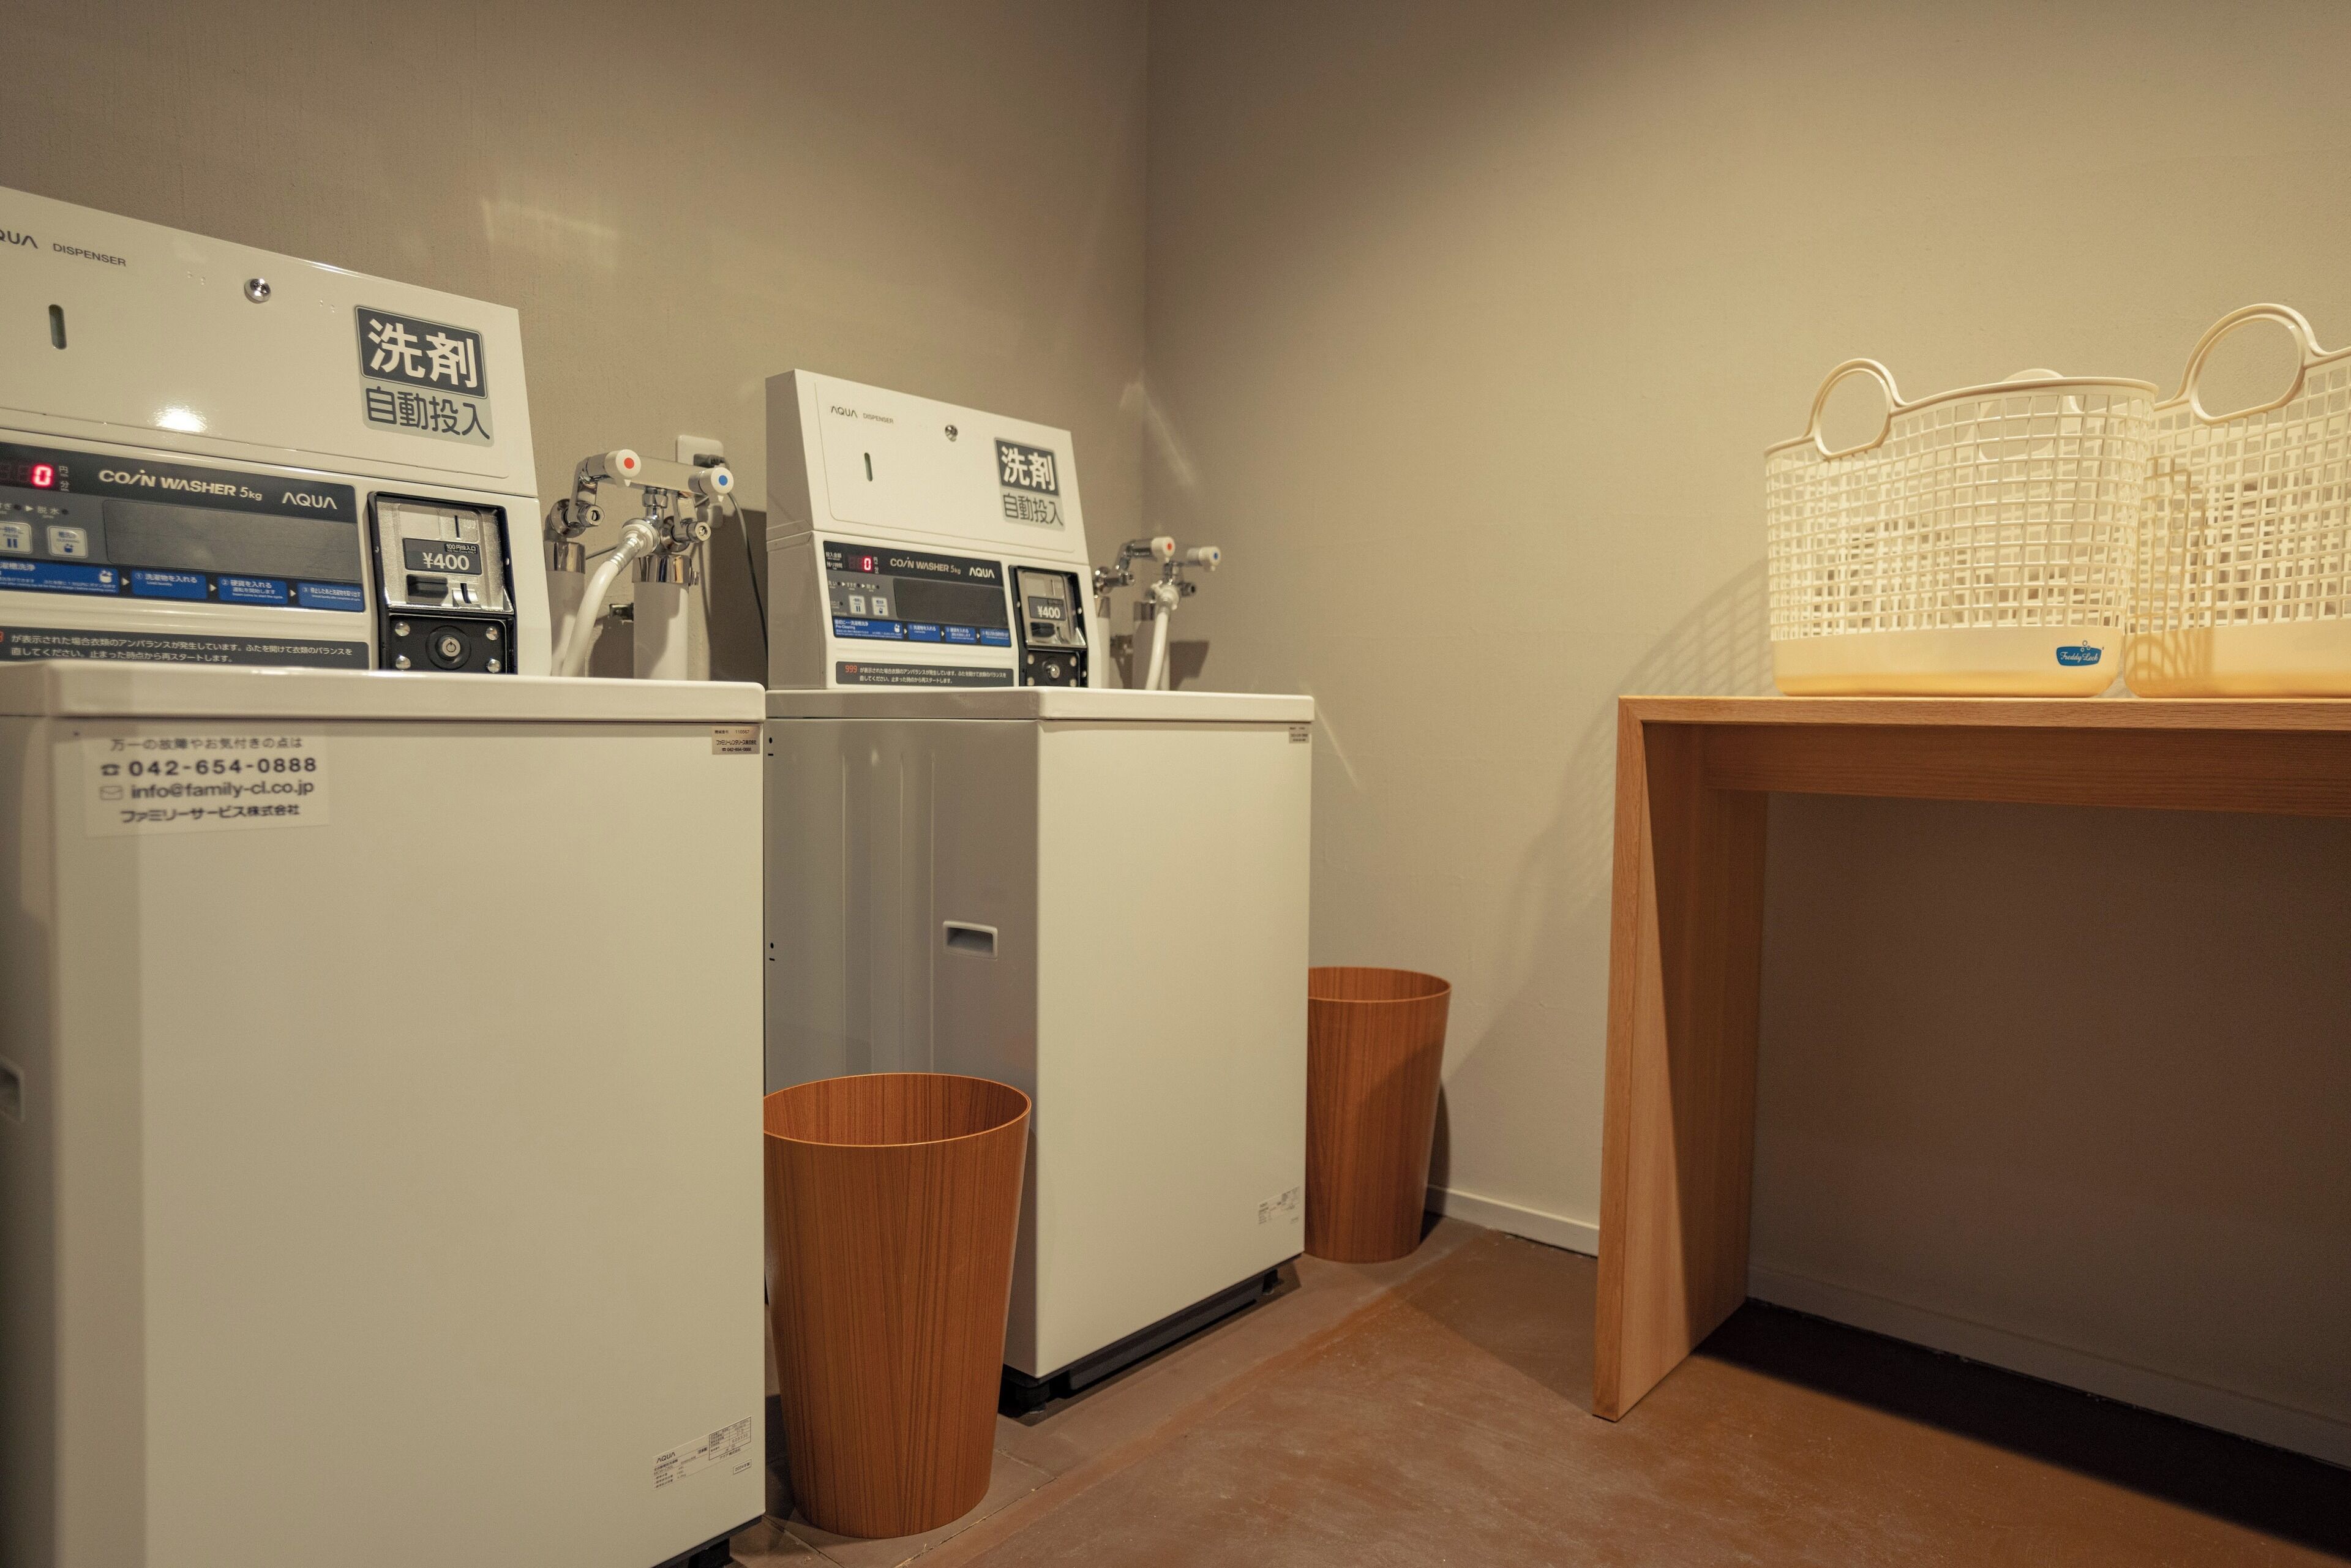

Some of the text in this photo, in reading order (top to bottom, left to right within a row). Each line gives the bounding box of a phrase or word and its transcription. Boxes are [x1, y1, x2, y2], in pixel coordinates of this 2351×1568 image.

[53, 243, 127, 267] DISPENSER
[368, 318, 478, 388] 洗剤
[366, 386, 490, 440] 自動投入
[831, 405, 894, 424] AQUA DISPENSER
[33, 465, 53, 486] 0
[1001, 446, 1056, 491] 洗剤
[160, 477, 236, 497] WASHER
[239, 487, 263, 501] 5kg
[281, 492, 338, 510] AQUA
[1003, 493, 1063, 527] 自動投入
[422, 552, 470, 571] ¥400
[863, 557, 872, 571] 0
[915, 561, 949, 572] WASHER
[950, 565, 961, 575] 5kg
[969, 567, 996, 579] AQUA
[1037, 606, 1061, 619] ¥400
[2060, 651, 2082, 663] Freddy
[110, 737, 302, 752] 万一の故障やお気付きの点は
[129, 757, 317, 776] 042-654-0888
[131, 779, 314, 800] info@family-cl.co.jp
[119, 803, 301, 823] ファミリーサービス株式会社
[656, 1452, 676, 1464] AQUA
